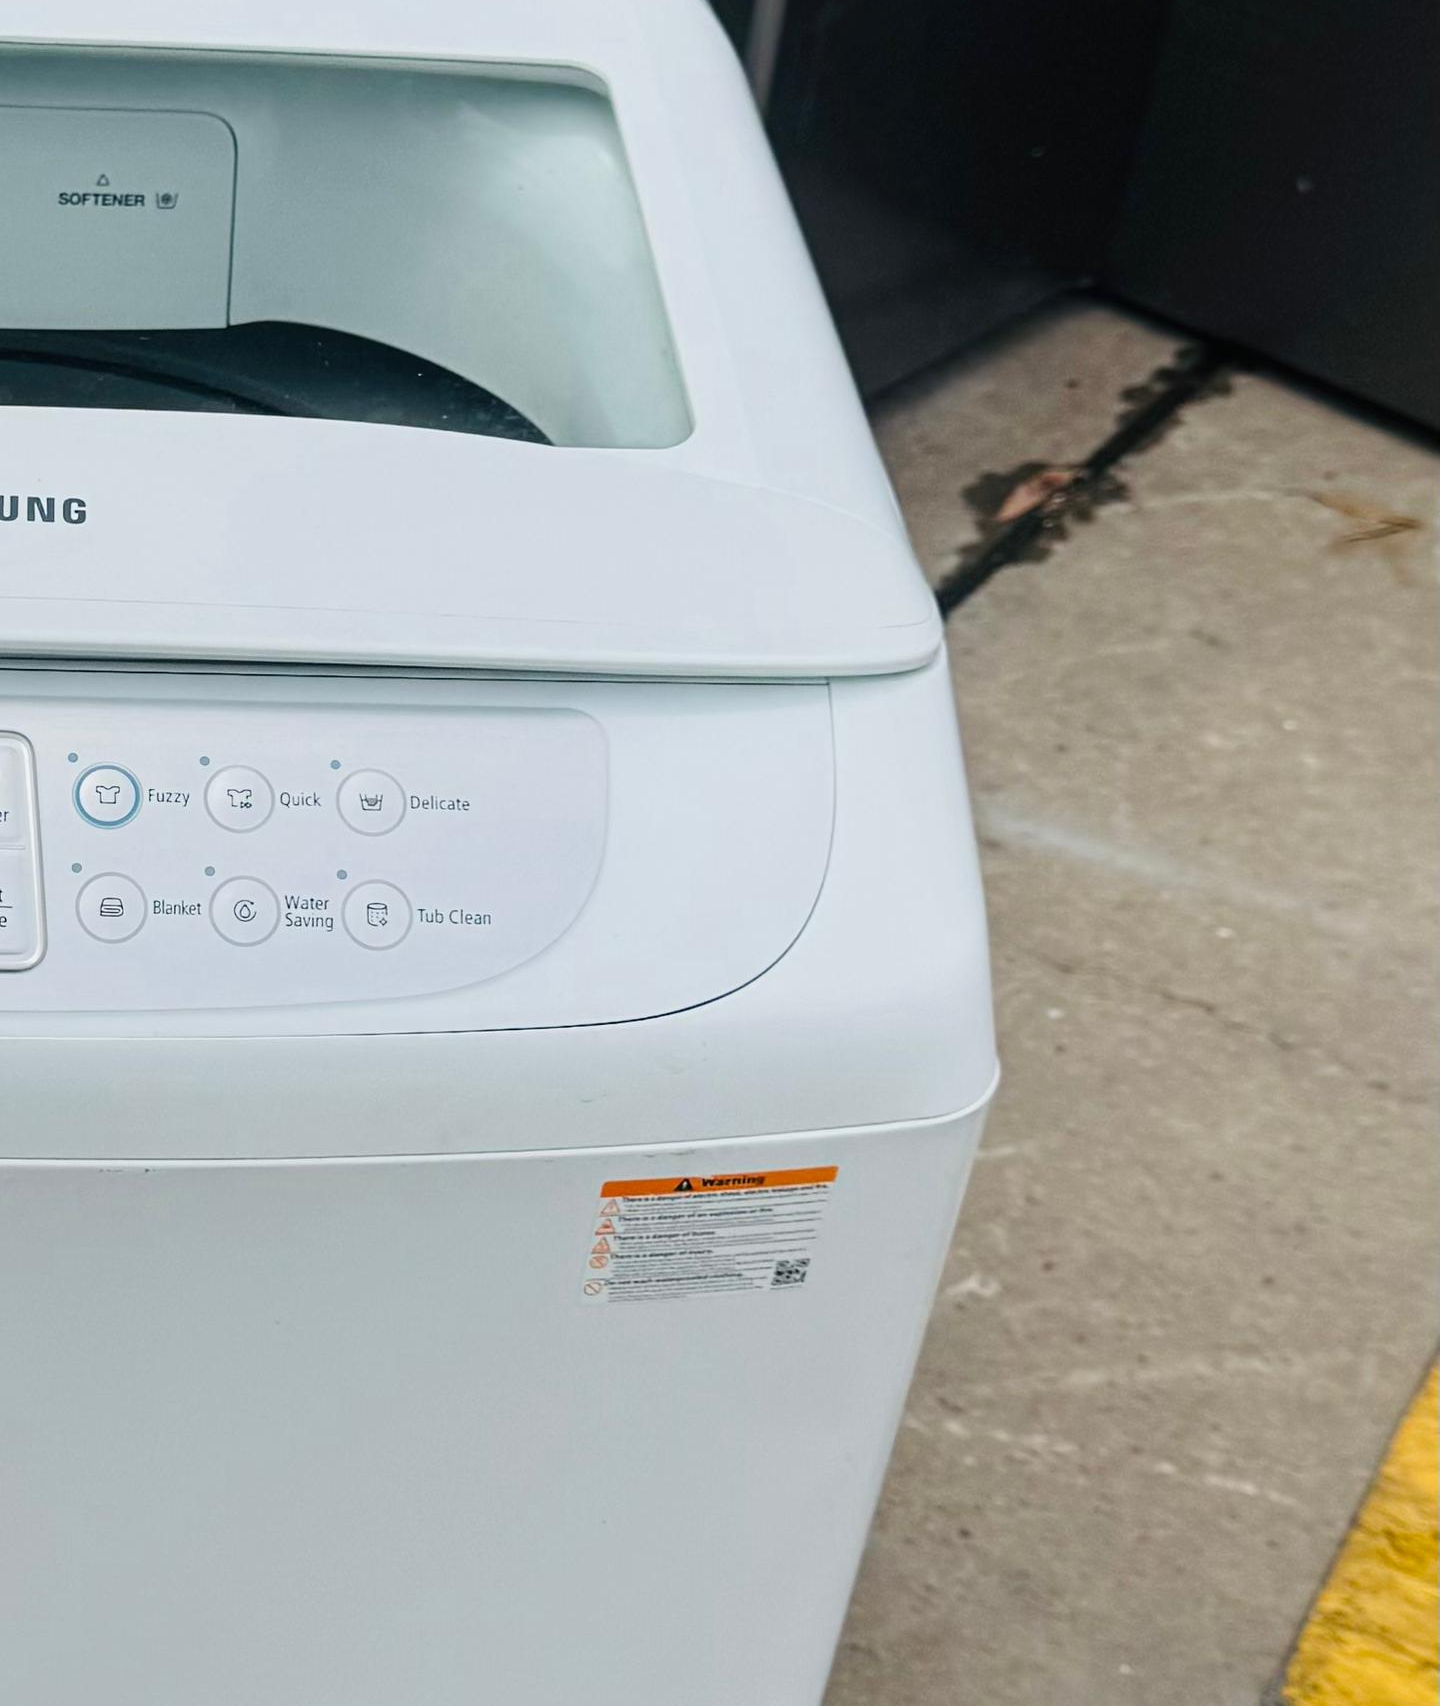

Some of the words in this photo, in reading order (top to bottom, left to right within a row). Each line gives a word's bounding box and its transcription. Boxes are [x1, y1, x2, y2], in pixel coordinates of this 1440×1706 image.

[58, 191, 146, 207] SOFTENER
[148, 788, 190, 807] Fuzzy
[279, 791, 322, 809] Quick
[410, 795, 471, 812] Delicate
[153, 899, 201, 916] Blanket
[284, 895, 330, 911] Water
[285, 911, 335, 933] Saving
[417, 908, 445, 924] Tub
[448, 908, 492, 926] Clean
[702, 1174, 766, 1188] Warning
